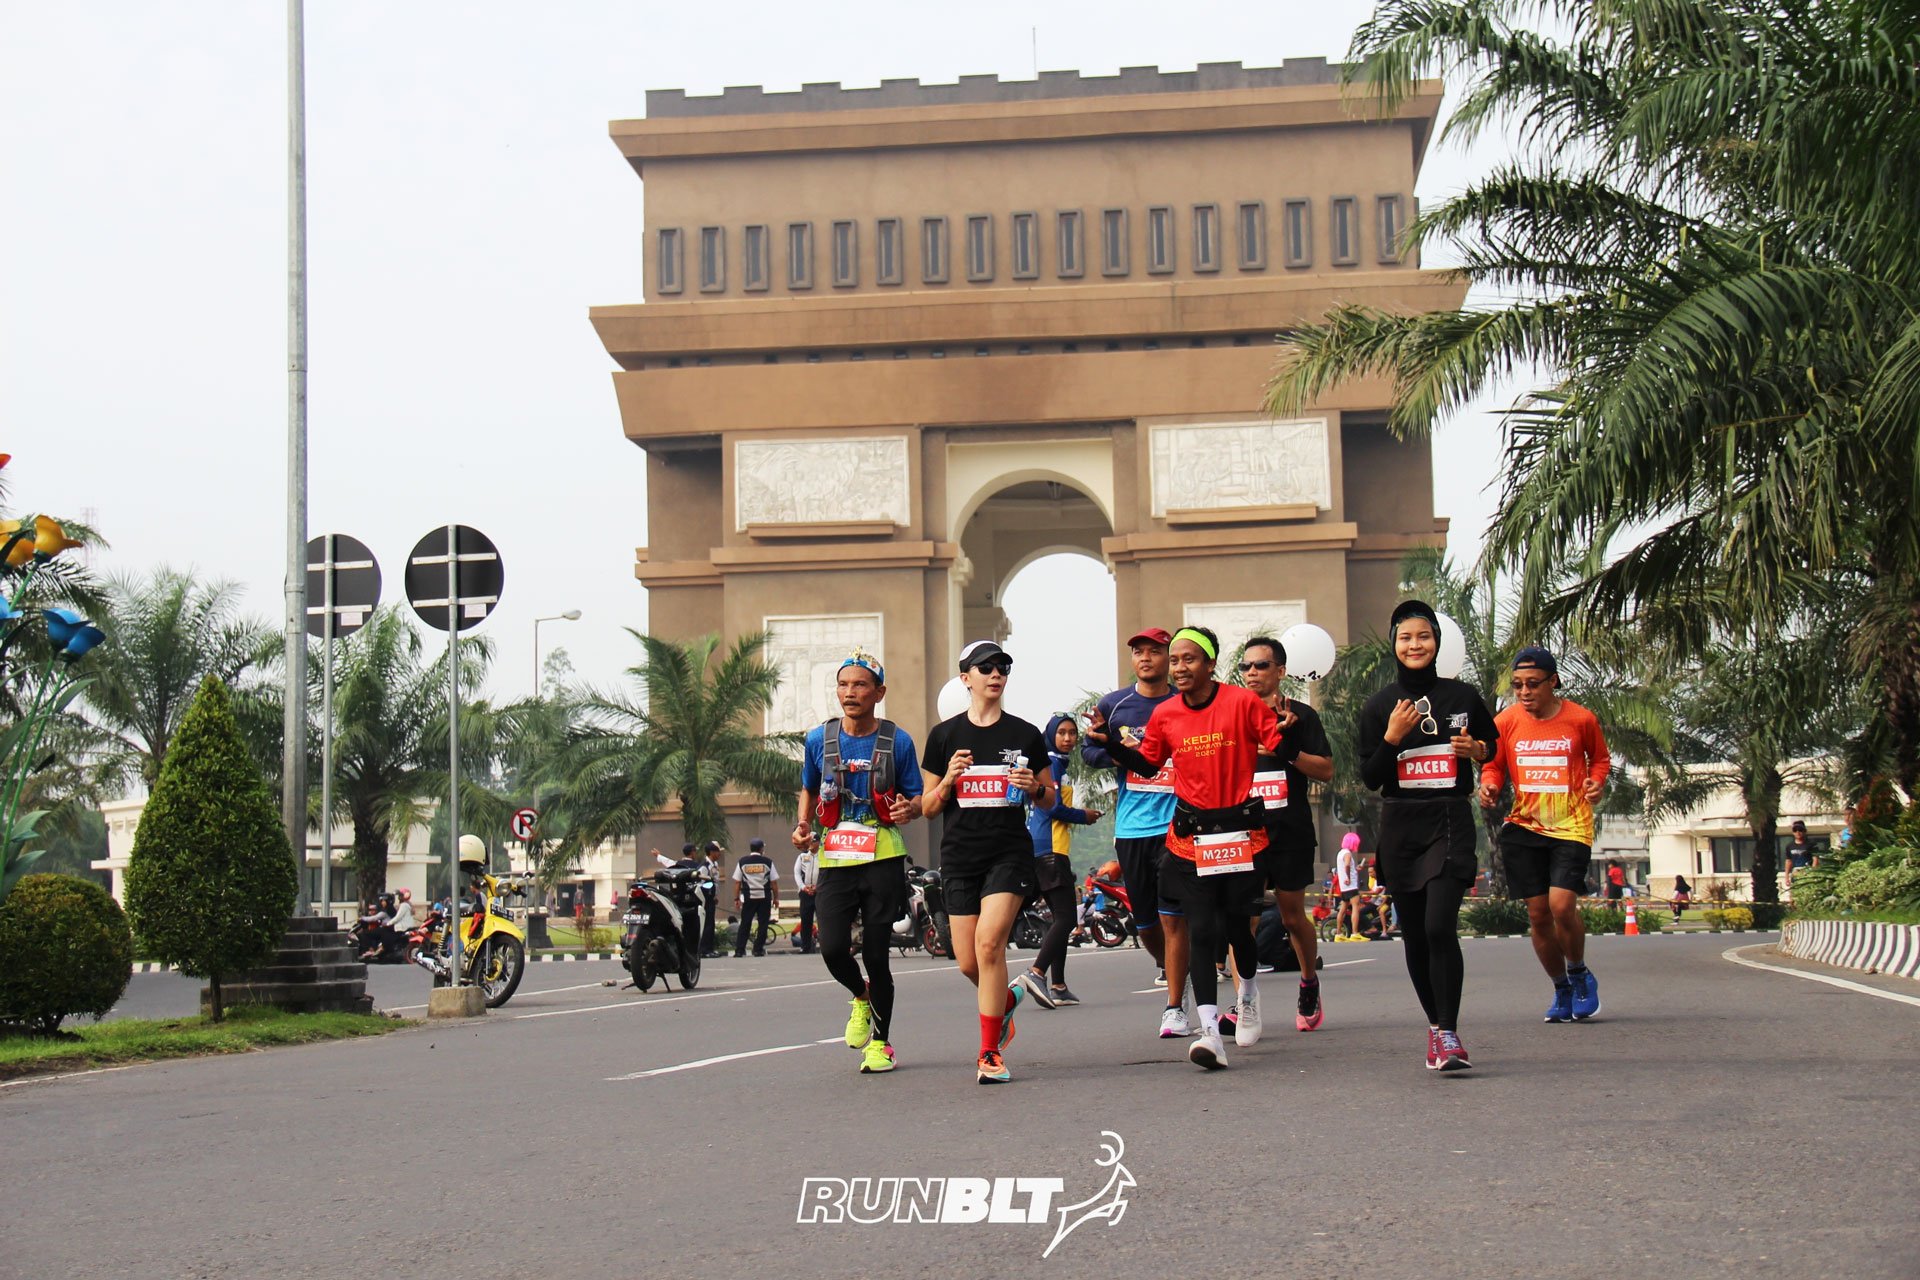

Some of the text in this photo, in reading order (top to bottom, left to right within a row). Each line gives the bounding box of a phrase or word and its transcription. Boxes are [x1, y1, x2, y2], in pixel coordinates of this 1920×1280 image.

[1183, 732, 1223, 745] KEDIRI
[1405, 760, 1449, 775] PACER
[1525, 770, 1559, 780] F2774
[962, 780, 1003, 793] PACER
[1249, 785, 1280, 798] ACER
[830, 834, 869, 846] M2147
[1202, 846, 1243, 861] M2251
